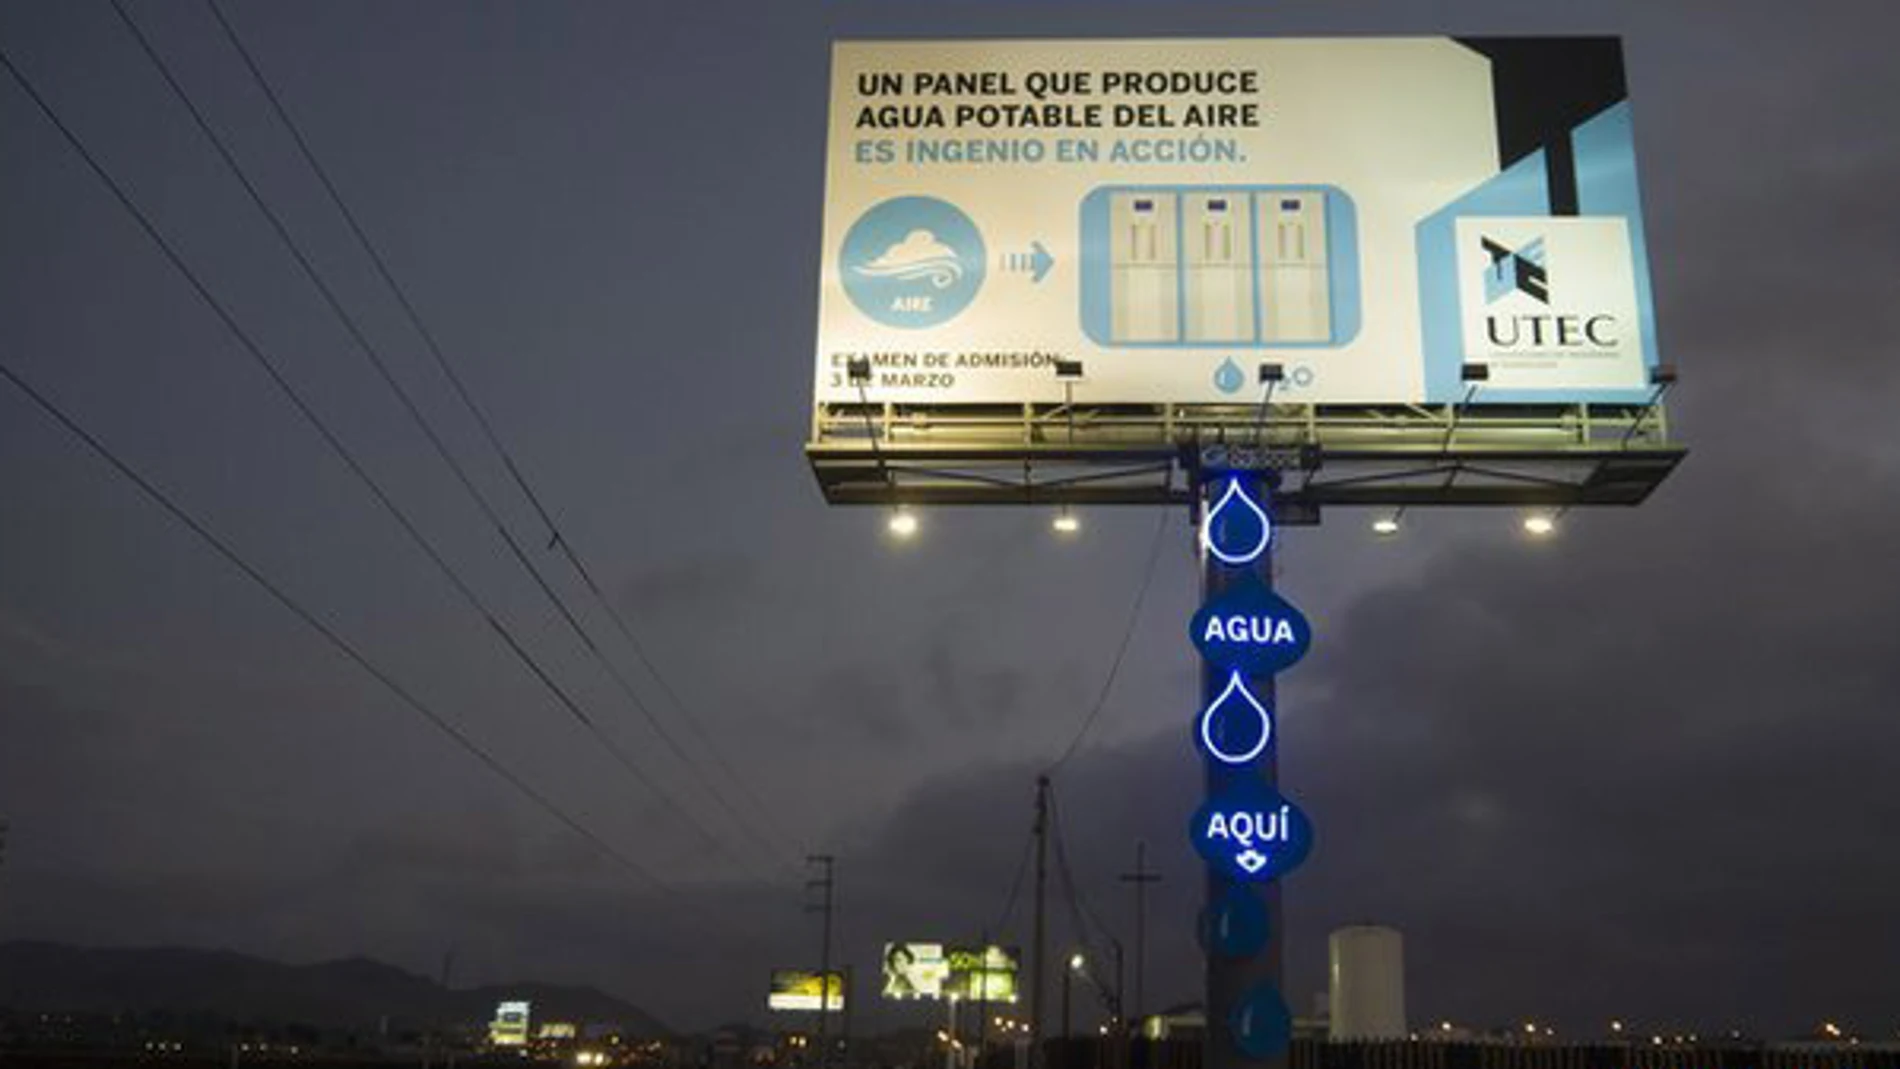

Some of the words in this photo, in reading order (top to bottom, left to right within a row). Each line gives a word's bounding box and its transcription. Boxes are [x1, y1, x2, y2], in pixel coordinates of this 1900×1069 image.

[857, 74, 902, 96] UN
[914, 73, 1016, 95] PANEL
[1025, 73, 1092, 96] QUE
[1102, 72, 1259, 94] PRODUCE
[855, 106, 945, 128] AGUA
[955, 105, 1102, 128] POTABLE
[1113, 105, 1175, 127] DEL
[1183, 104, 1260, 127] AIRE
[855, 140, 896, 163] ES
[906, 140, 1046, 163] INGENIO
[1056, 140, 1099, 162] EN
[1109, 134, 1247, 162] ACCIÓN.
[891, 297, 933, 312] AIRE
[1486, 314, 1618, 347] UTEC
[923, 352, 951, 368] DE
[830, 371, 842, 388] 3
[881, 372, 955, 388] MARZO
[1204, 616, 1294, 642] AGUA
[1207, 805, 1290, 847] AQUÍ
